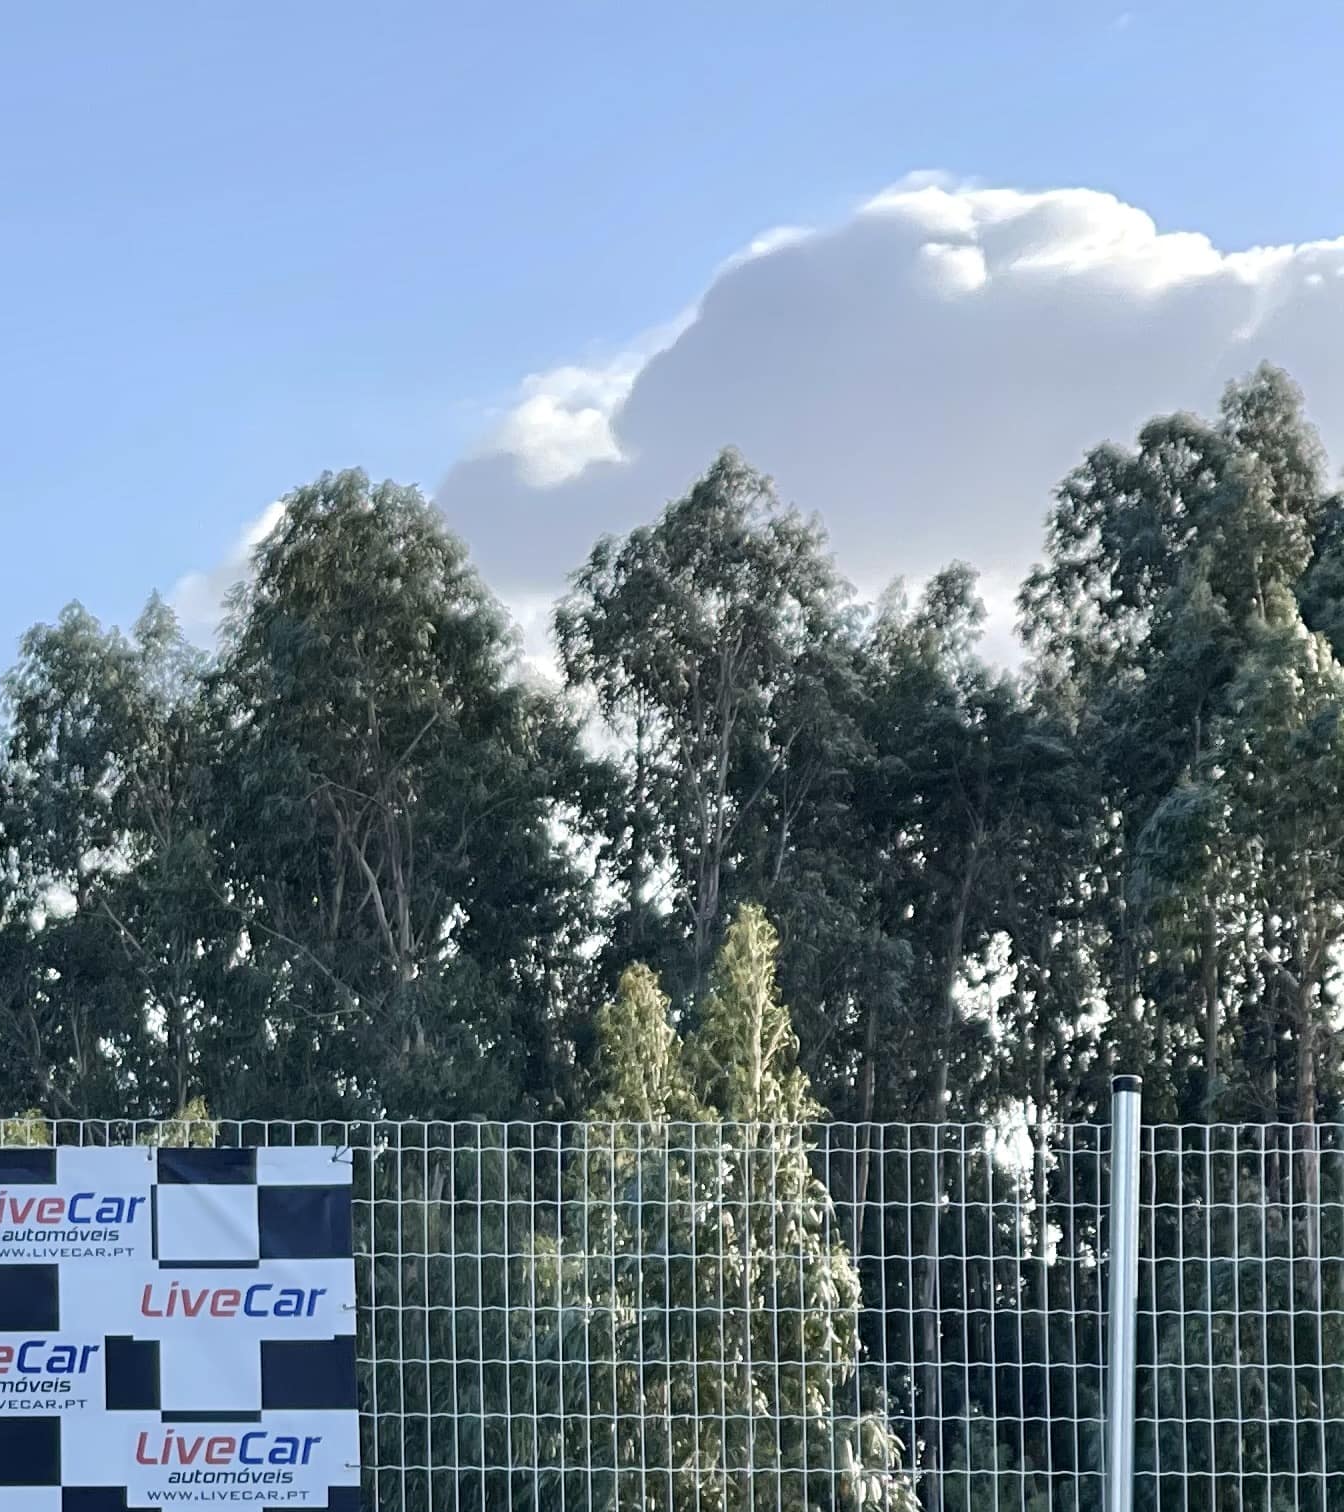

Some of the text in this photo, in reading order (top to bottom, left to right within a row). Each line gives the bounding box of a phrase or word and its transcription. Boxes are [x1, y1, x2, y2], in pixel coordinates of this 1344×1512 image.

[2, 1227, 119, 1243] automóveis
[141, 1282, 326, 1318] LiveCar
[136, 1430, 321, 1466] LiveCar
[168, 1467, 293, 1484] automóveis
[147, 1490, 310, 1500] WWW.LIVECAR.PT
